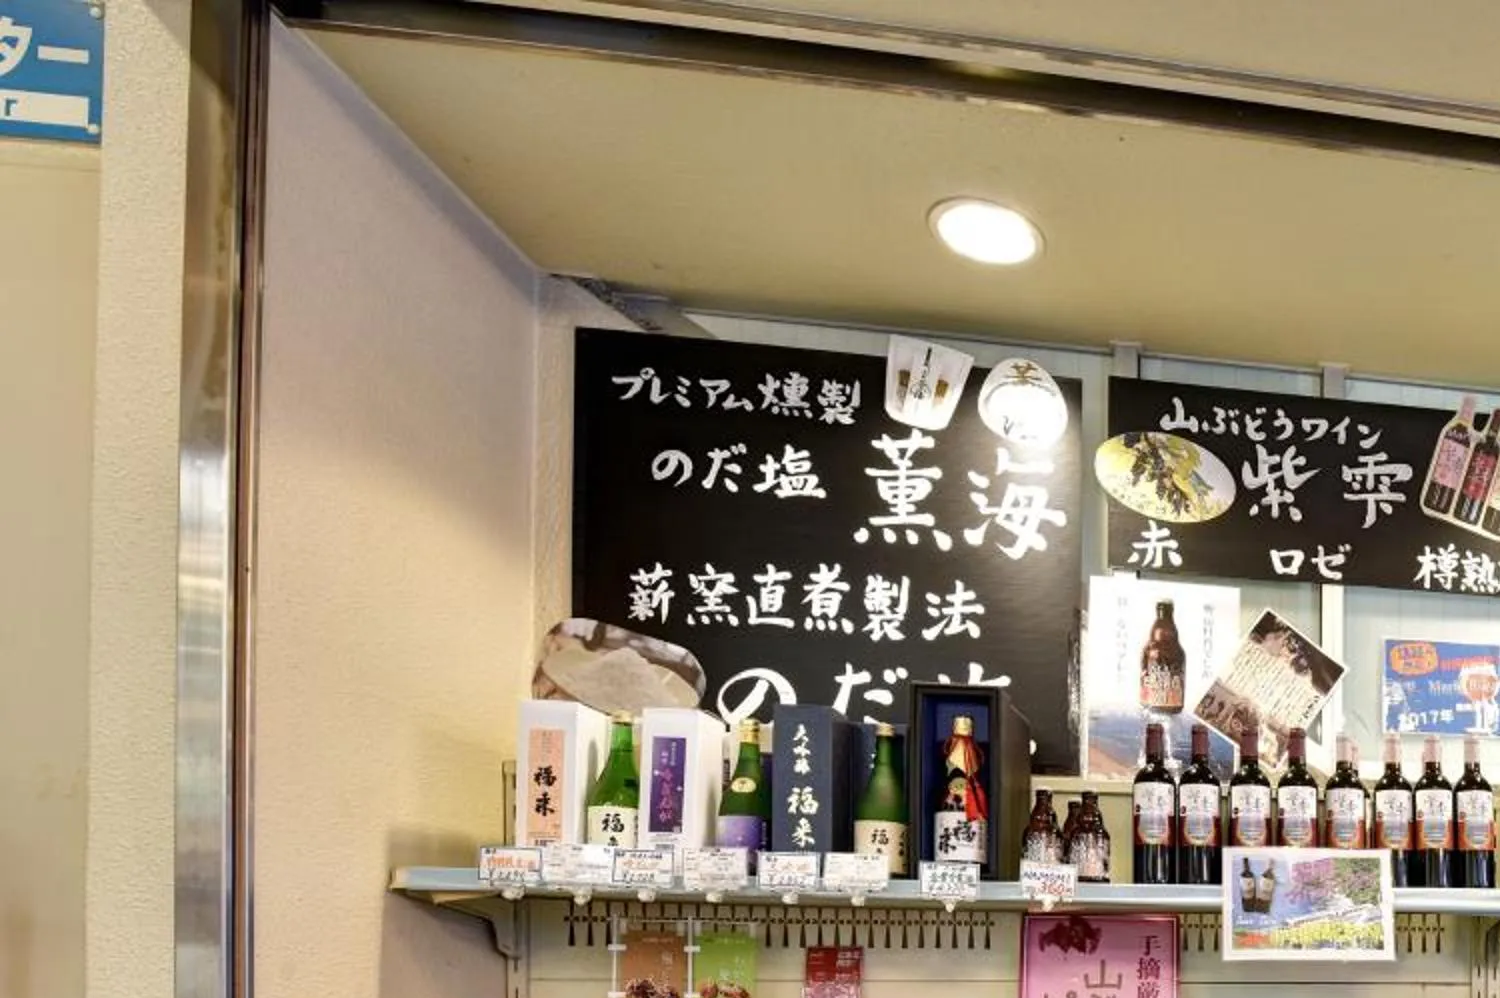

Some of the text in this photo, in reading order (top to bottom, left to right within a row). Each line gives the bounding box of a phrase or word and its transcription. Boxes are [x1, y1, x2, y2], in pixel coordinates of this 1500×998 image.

[1159, 396, 1384, 449] 山ぶどうワイン
[651, 442, 827, 499] のだ塩
[1240, 443, 1414, 530] 紫雫
[1127, 520, 1183, 569] 赤
[1268, 543, 1353, 580] ロゼ
[628, 560, 987, 643] 薪窯直煮製法
[717, 661, 1012, 733] のだ
